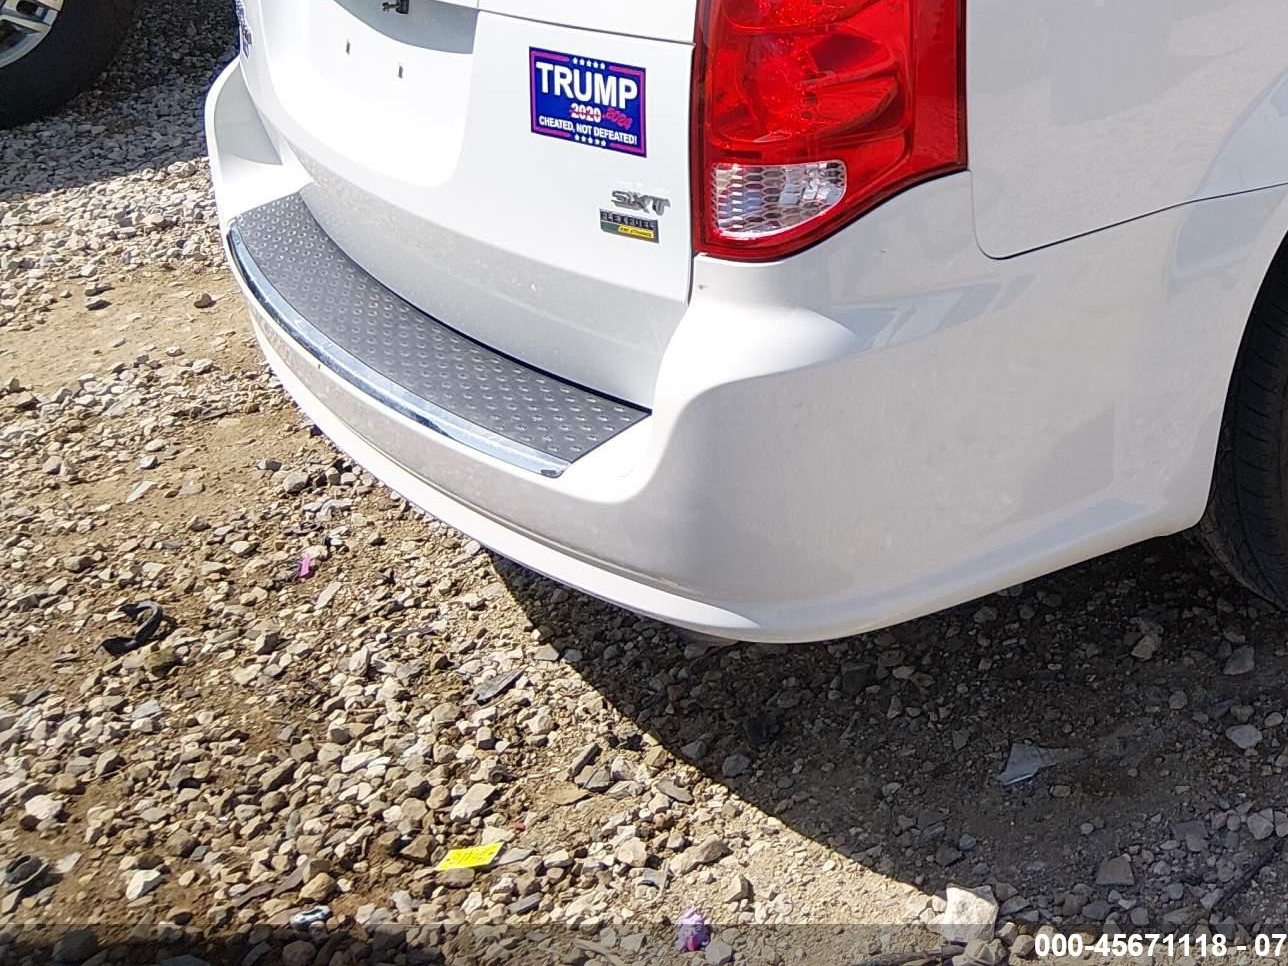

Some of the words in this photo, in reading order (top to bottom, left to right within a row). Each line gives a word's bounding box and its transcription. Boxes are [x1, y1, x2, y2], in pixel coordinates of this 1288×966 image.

[536, 61, 638, 109] TRUMP
[570, 102, 602, 123] 2020
[538, 115, 576, 133] CHEATED,
[576, 122, 593, 135] NOT
[594, 127, 638, 145] DEFEATED!
[611, 190, 671, 216] SXT
